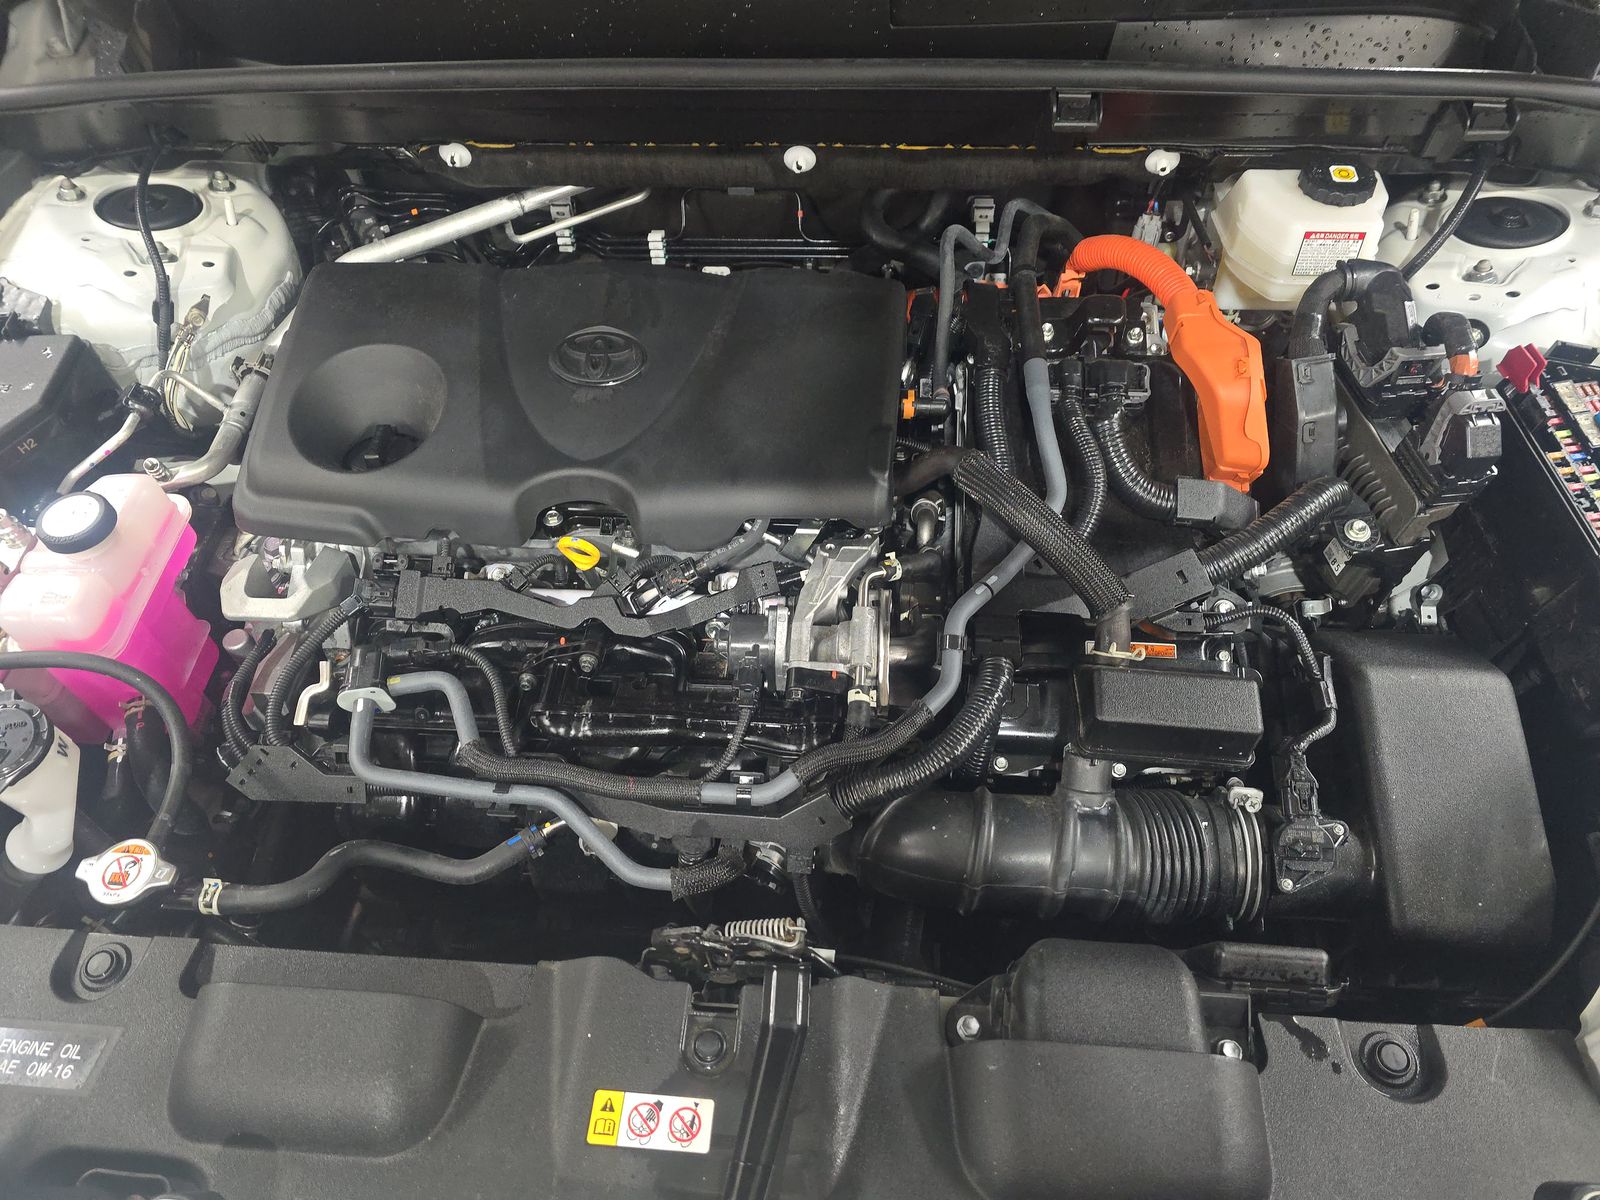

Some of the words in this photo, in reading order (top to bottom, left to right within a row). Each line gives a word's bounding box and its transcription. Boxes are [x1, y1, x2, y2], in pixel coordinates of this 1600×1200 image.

[1324, 232, 1350, 240] DANGER
[17, 438, 38, 454] H2
[0, 1039, 54, 1057] ENGINE
[60, 1044, 81, 1060] OIL
[26, 1061, 74, 1080] 0W-16
